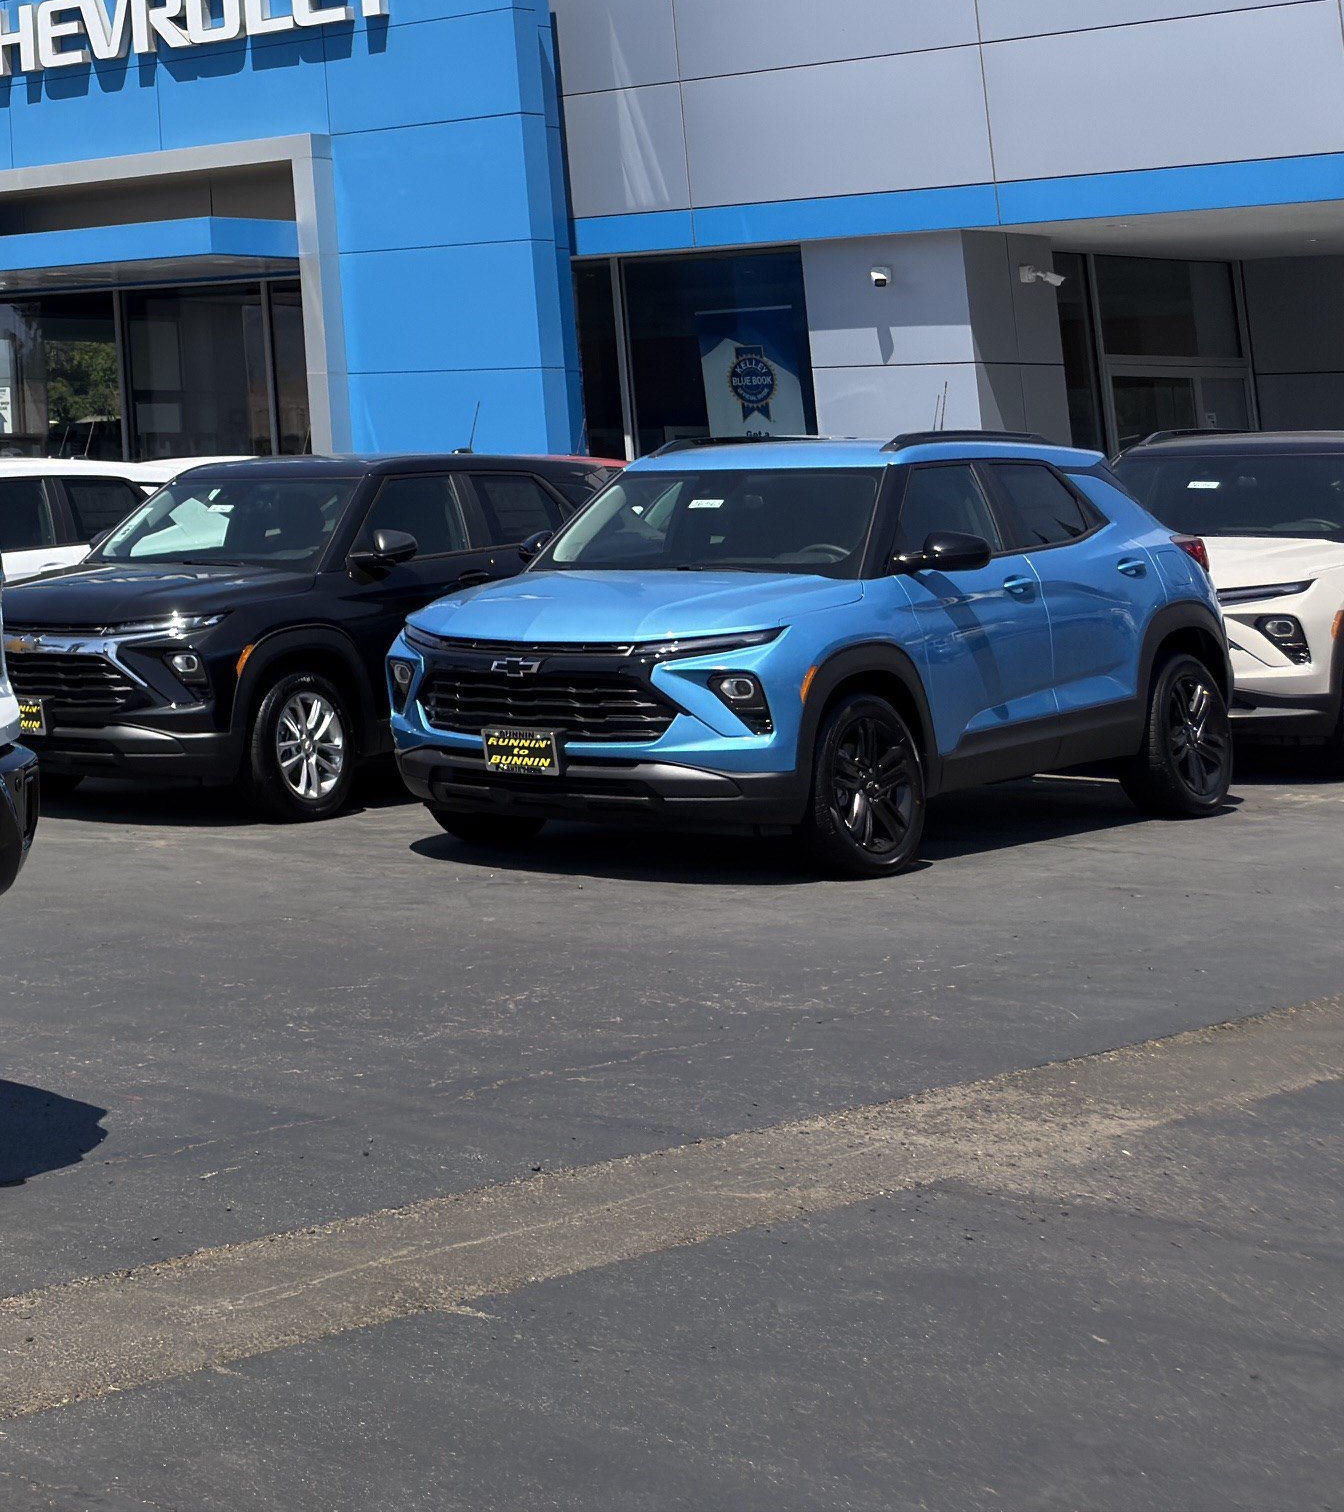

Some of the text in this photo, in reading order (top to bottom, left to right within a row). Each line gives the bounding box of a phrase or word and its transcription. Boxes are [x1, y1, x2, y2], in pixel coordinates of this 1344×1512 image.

[735, 359, 768, 374] KELLEY
[732, 376, 773, 386] BLUE BOOK
[20, 720, 41, 728] NIN
[487, 737, 551, 748] RUNNIN'
[490, 754, 551, 767] BUNNIN
